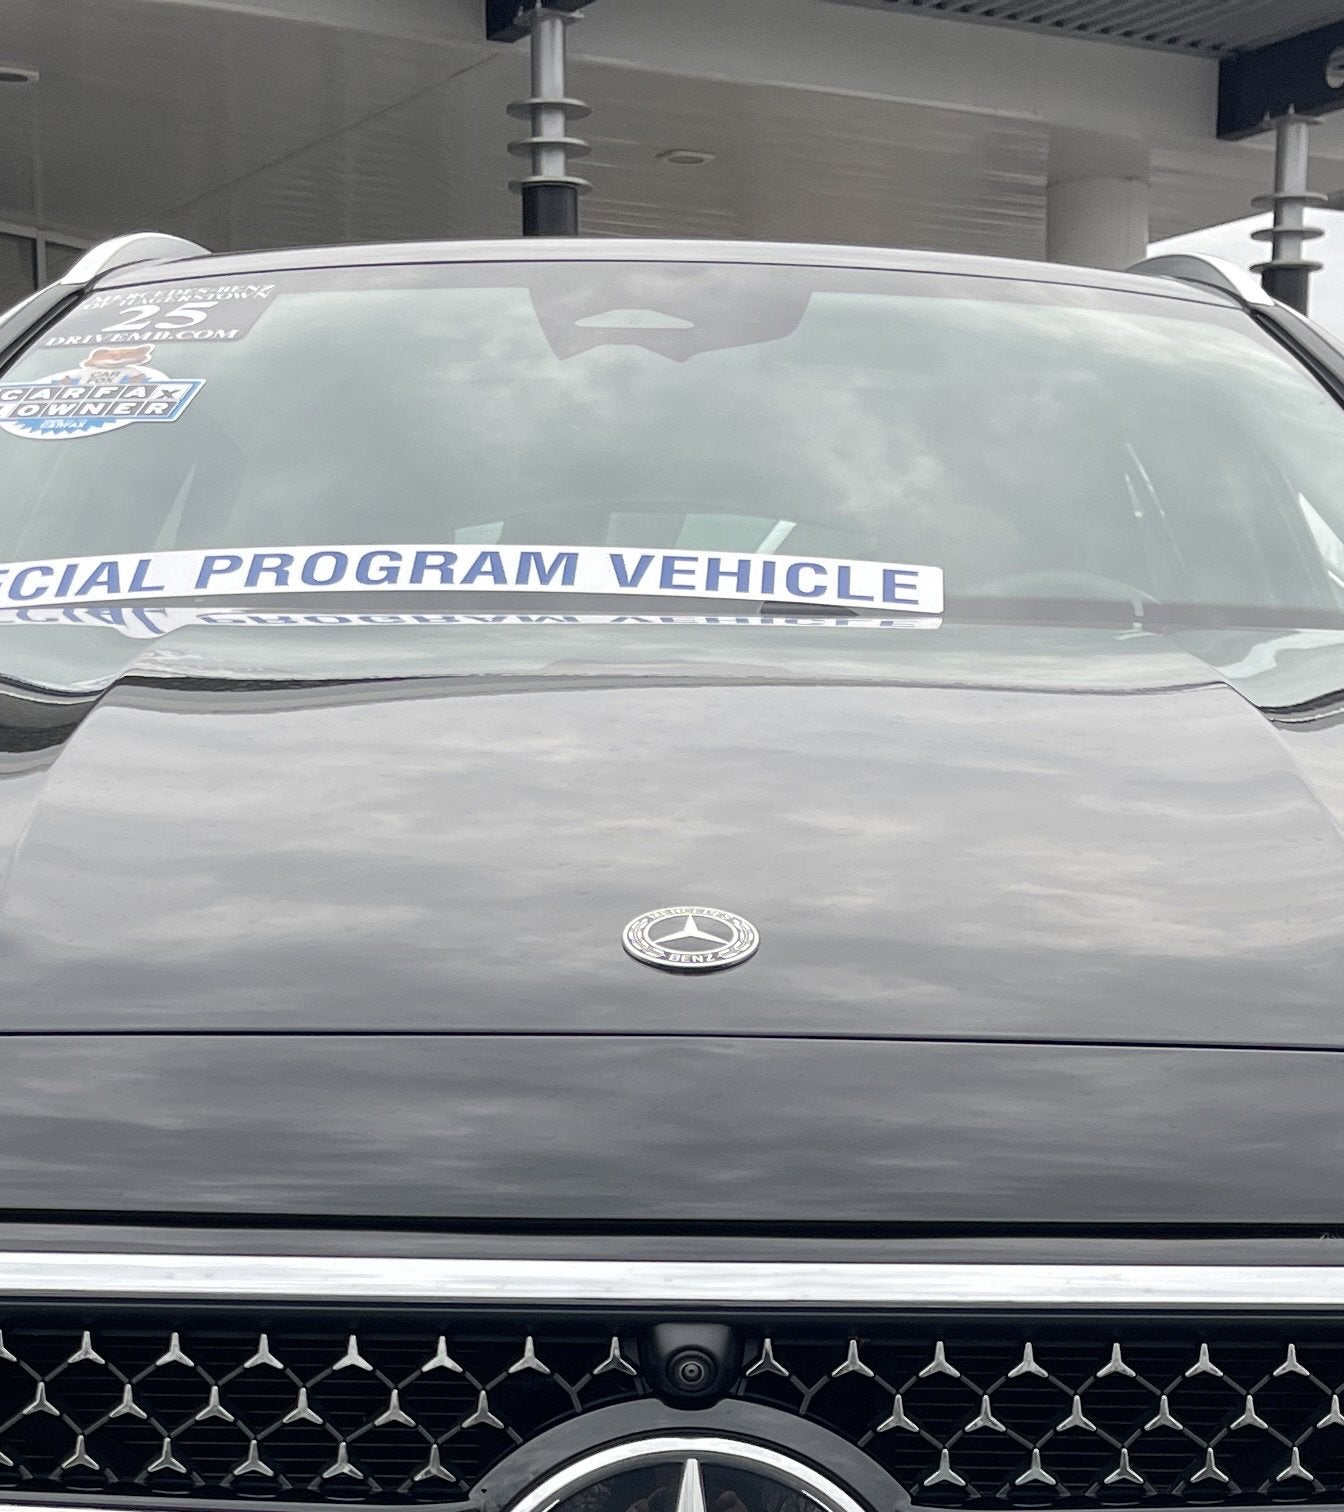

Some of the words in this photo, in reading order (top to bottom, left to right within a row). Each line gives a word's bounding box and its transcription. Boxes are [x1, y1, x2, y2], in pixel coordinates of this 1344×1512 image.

[101, 301, 220, 332] 25
[45, 329, 241, 346] DRIVEMB.COM
[0, 386, 181, 401] CARFAX
[16, 402, 170, 417] OWNER
[195, 550, 580, 590] PROGRAM
[609, 553, 920, 605] VEHICLE
[668, 953, 716, 963] BENZ
